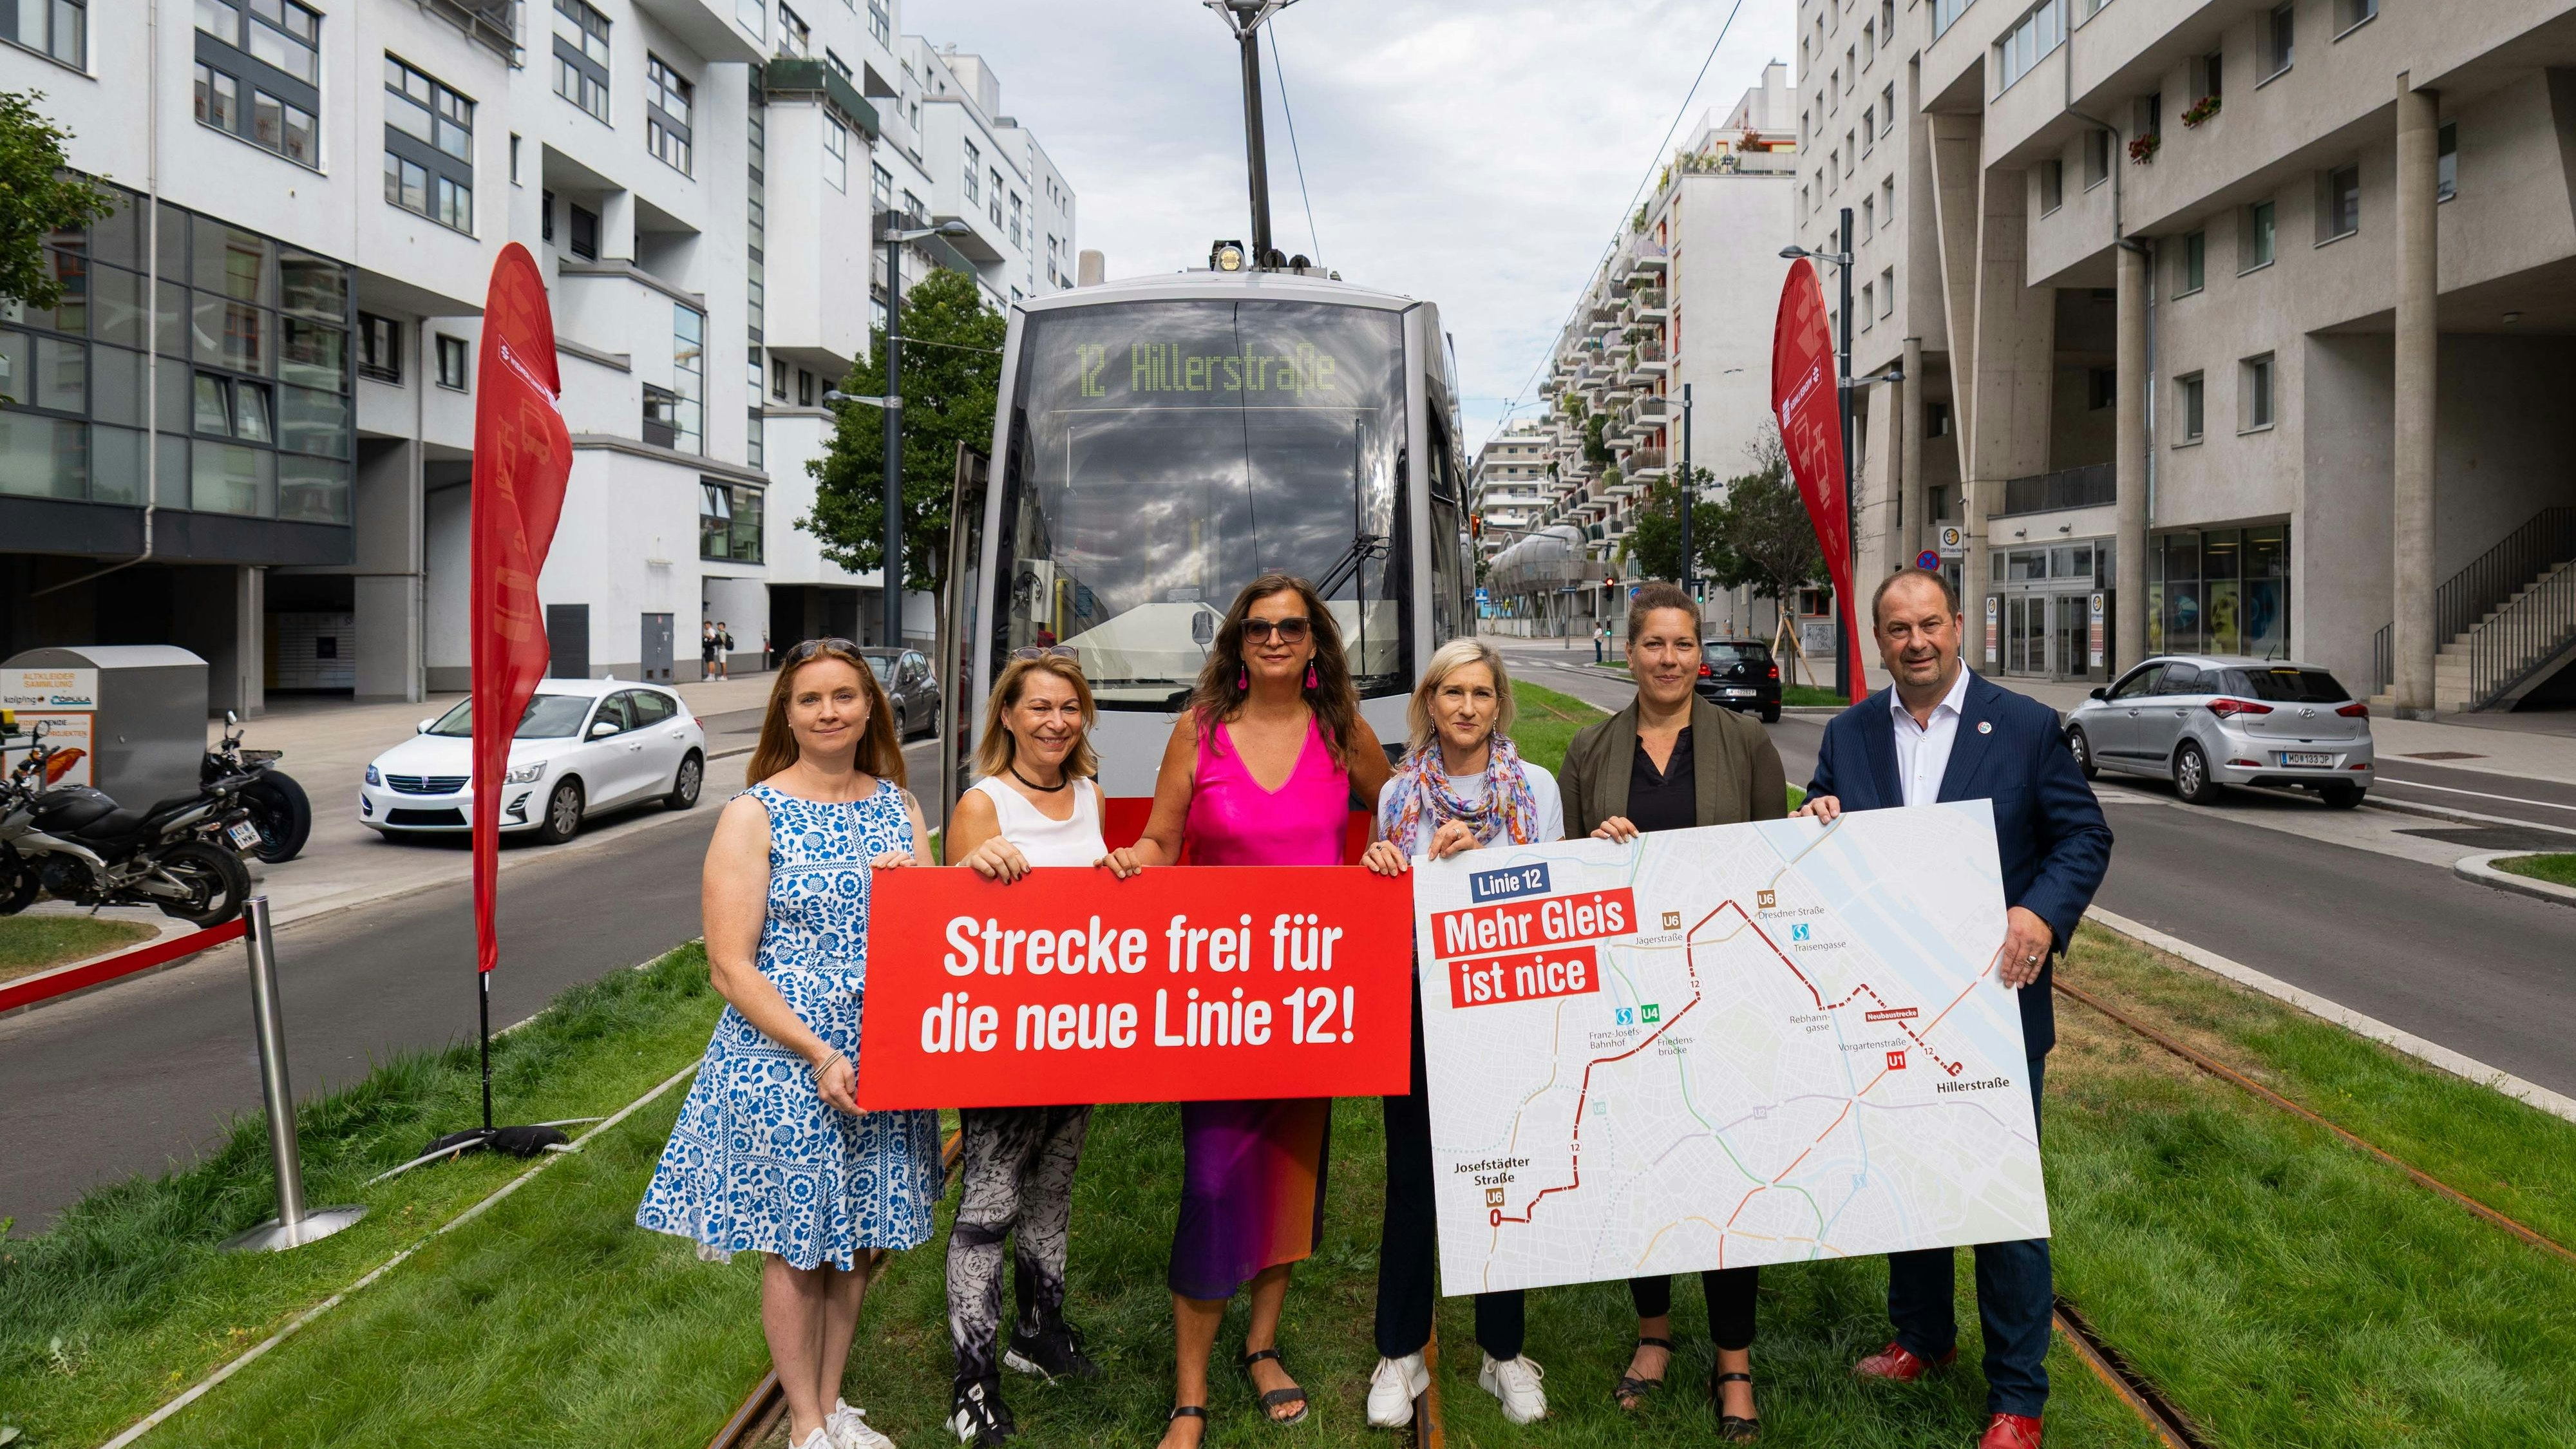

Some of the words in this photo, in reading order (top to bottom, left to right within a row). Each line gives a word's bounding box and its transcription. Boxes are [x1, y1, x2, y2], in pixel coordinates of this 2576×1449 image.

[1075, 343, 1106, 397] 12
[1131, 342, 1335, 397] Hillerstraße
[2288, 753, 2299, 762] MD
[2305, 754, 2318, 763] 133
[2320, 755, 2329, 764] JP
[1478, 873, 1520, 896] Linie
[1522, 869, 1542, 889] 12
[1758, 894, 1774, 905] U6
[1758, 910, 1795, 920] Dresdner
[1798, 906, 1825, 915] Straße
[1444, 908, 1532, 954] Mehr
[1541, 895, 1625, 940] Gleis
[1664, 915, 1680, 927] U6
[943, 914, 1148, 977] Strecke
[1165, 913, 1252, 974] frei
[1269, 913, 1343, 972] für
[1635, 933, 1683, 945] Jägerstraße
[1794, 940, 1846, 952] Traisengasse
[1461, 963, 1506, 1003] ist
[1515, 955, 1586, 997] nice
[921, 990, 999, 1054] die
[1015, 1002, 1139, 1052] neue
[1154, 985, 1273, 1048] Linie
[1282, 985, 1355, 1044] 12!
[1642, 1009, 1658, 1019] U4
[1790, 1014, 1830, 1024] Rebhann-
[1868, 1010, 1917, 1020] Neubaustrecke
[1589, 1027, 1642, 1040] Franz-Josefs-
[1806, 1023, 1830, 1034] gasse
[1591, 1038, 1625, 1050] Bahnhof
[1658, 1036, 1696, 1046] Friedens-
[1838, 1038, 1907, 1053] Vorgartenstraße
[1658, 1046, 1687, 1056] brücke
[1924, 1047, 1934, 1056] 12
[1888, 1054, 1905, 1068] U1
[1937, 1077, 2010, 1094] Hillerstraße
[1754, 1108, 1766, 1117] U2
[1570, 1144, 1580, 1152] 12
[1454, 1157, 1530, 1173] Josefstädter
[1474, 1172, 1515, 1186] Straße
[1487, 1193, 1502, 1204] U6
